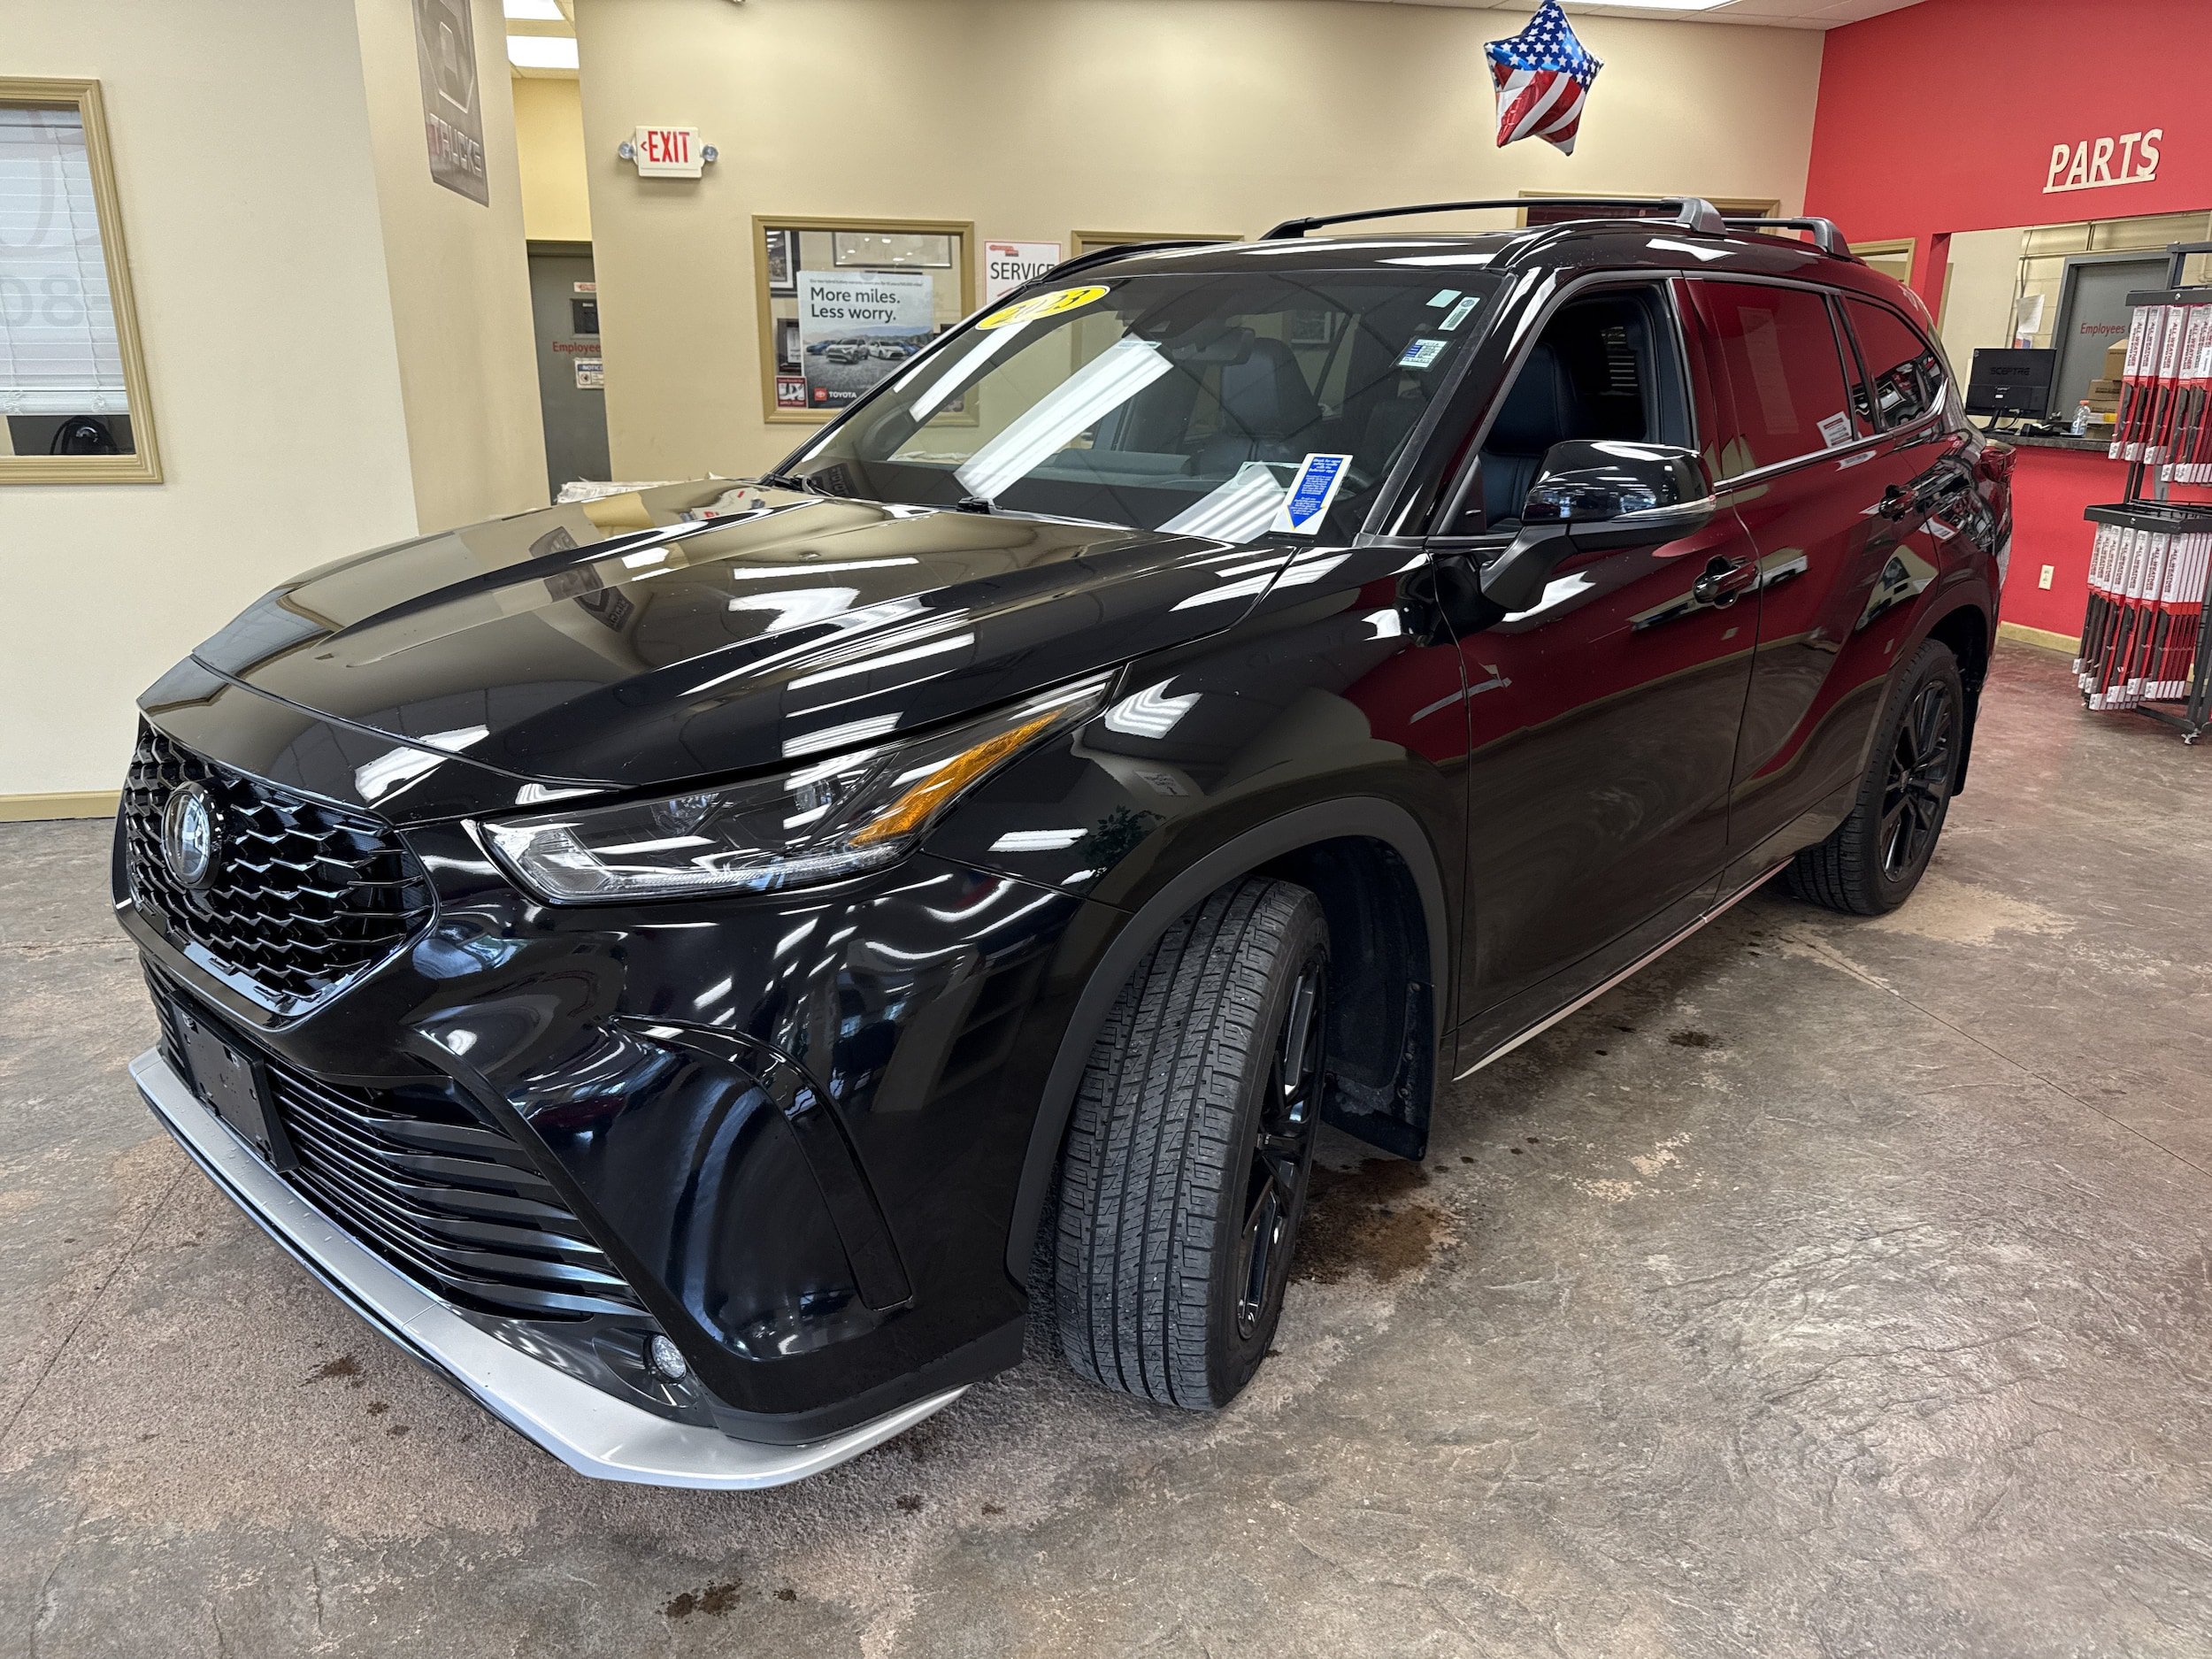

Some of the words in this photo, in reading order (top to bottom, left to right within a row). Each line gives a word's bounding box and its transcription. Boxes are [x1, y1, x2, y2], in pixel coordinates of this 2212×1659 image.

[648, 131, 690, 163] EXIT
[2043, 128, 2163, 192] PARTS
[810, 287, 851, 302] More
[856, 288, 901, 304] miles.
[811, 303, 844, 319] Less
[849, 309, 896, 324] worry.
[2080, 322, 2125, 337] Employees
[552, 342, 602, 355] Employee
[2131, 322, 2142, 366] ALL-WEATHER
[2165, 323, 2177, 369] ALL-WEATHER
[2186, 323, 2199, 370] ALL-WEATHER
[1991, 366, 2031, 376] SCEPTRE
